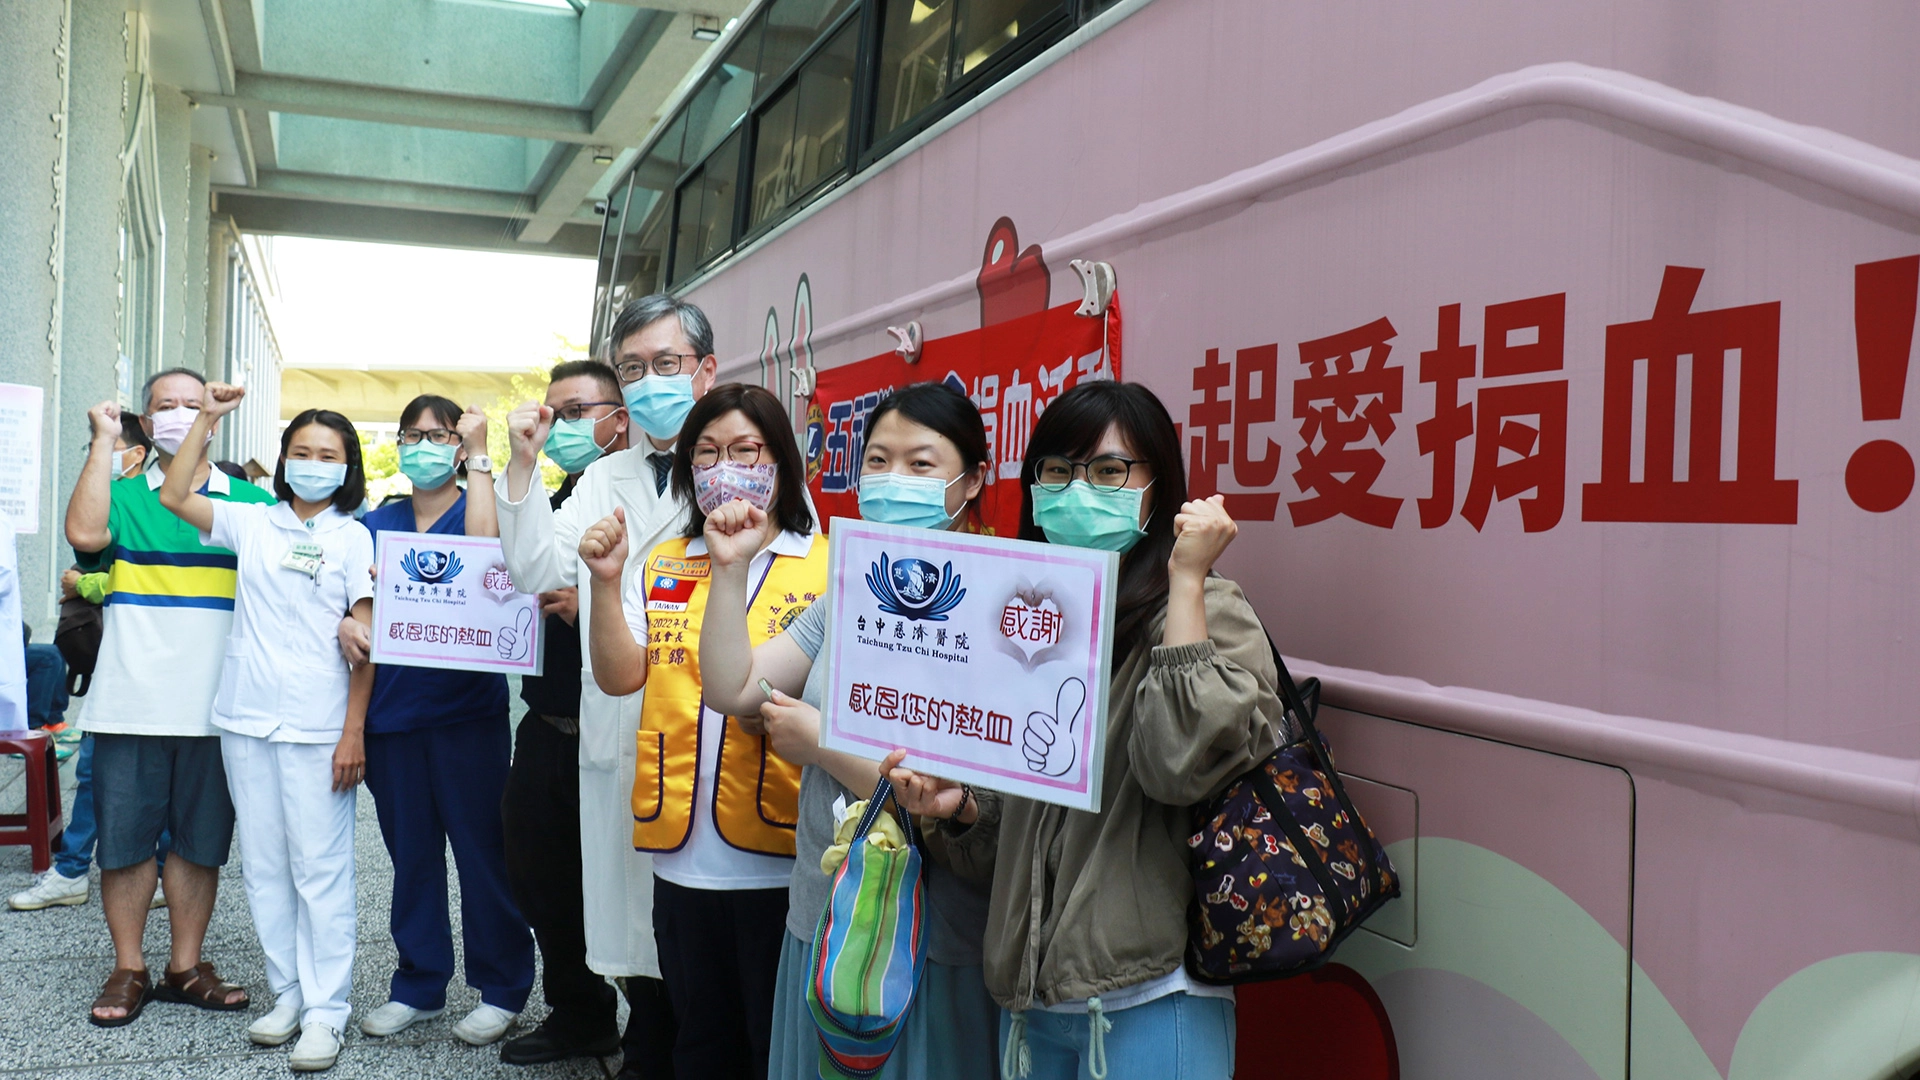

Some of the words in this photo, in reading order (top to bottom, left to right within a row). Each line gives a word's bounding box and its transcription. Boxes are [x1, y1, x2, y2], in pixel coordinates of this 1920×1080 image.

[1174, 254, 1920, 533] 起愛捐血!
[394, 595, 419, 603] Taichung
[654, 602, 680, 610] TAIWAN
[389, 622, 492, 647] 感恩您的熱血
[857, 614, 970, 651] 台中慈濟醫院
[1000, 605, 1063, 645] 感謝
[857, 635, 894, 652] Taichung
[896, 642, 912, 653] Tzu
[915, 646, 929, 656] Chi
[932, 649, 968, 664] Hospital
[849, 682, 1013, 746] 感恩您的熱血
